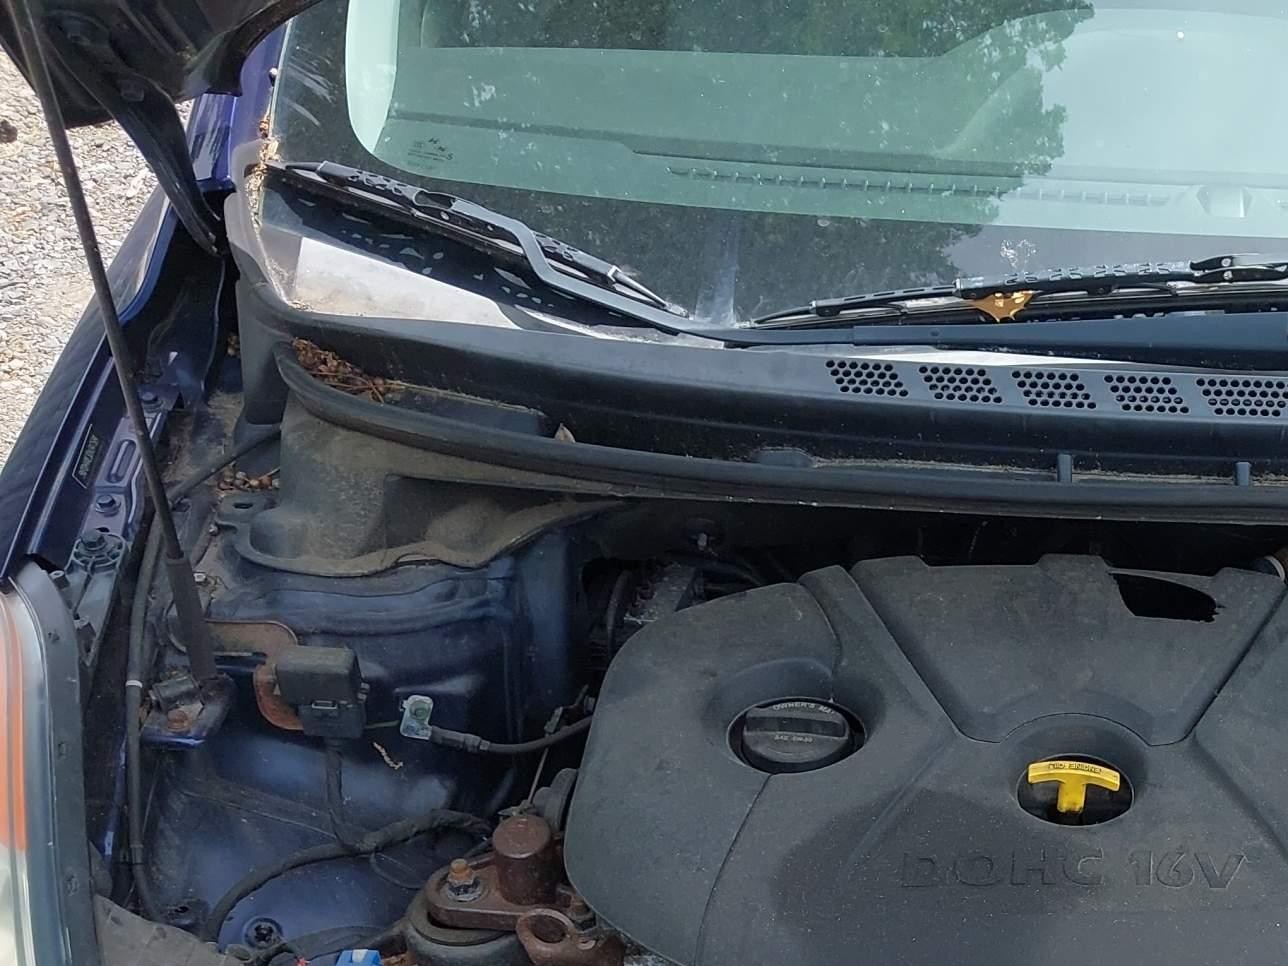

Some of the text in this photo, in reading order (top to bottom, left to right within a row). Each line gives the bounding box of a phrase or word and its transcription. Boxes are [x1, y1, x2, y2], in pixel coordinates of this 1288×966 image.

[1069, 763, 1102, 774] ENGINE
[899, 849, 1250, 889] DOHC 16V
